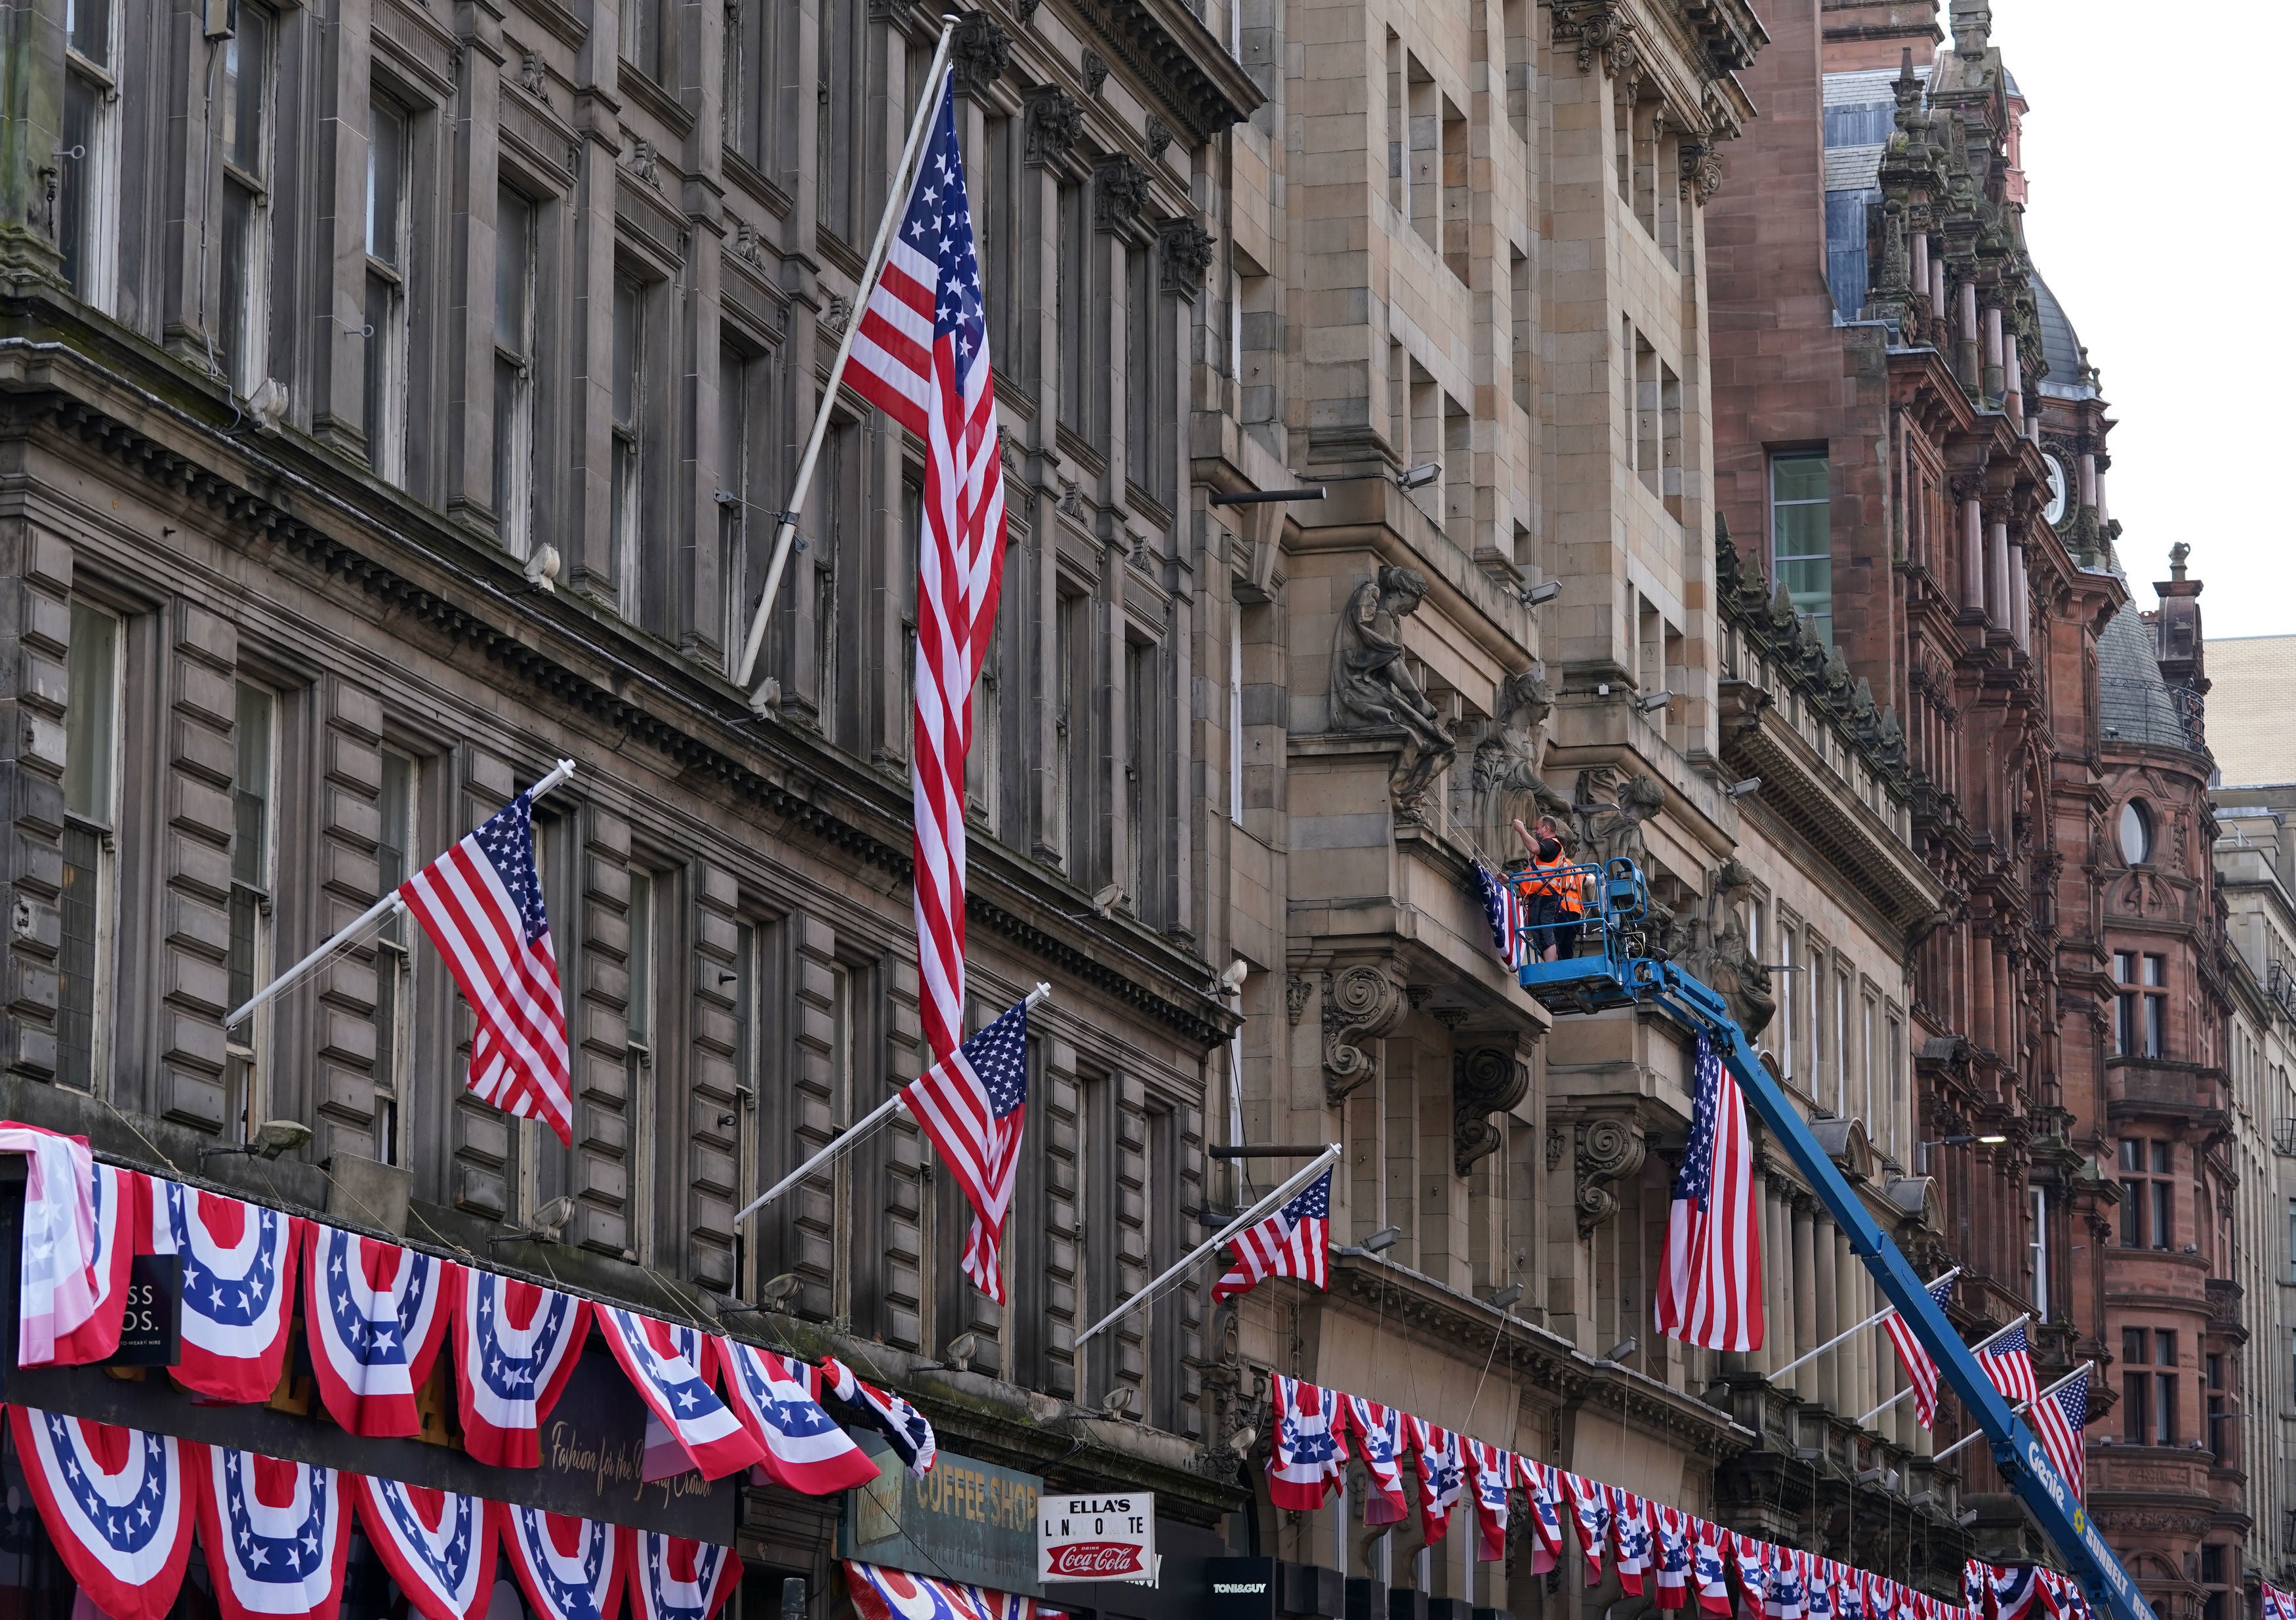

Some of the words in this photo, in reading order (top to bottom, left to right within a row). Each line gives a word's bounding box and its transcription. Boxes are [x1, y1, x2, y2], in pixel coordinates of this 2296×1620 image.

[127, 1285, 153, 1305] SS
[121, 1310, 159, 1331] OS.
[552, 1421, 597, 1473] Fashion
[597, 1436, 614, 1497] for
[615, 1440, 634, 1484] the
[2028, 1441, 2064, 1509] Genie
[916, 1462, 985, 1523] COFFEE
[990, 1476, 1037, 1533] SHOP
[1070, 1499, 1131, 1514] ELLA'S
[1059, 1546, 1132, 1572] Coca-Cola
[2086, 1525, 2129, 1597] SUNBELT
[1214, 1583, 1266, 1594] TONI&GUY
